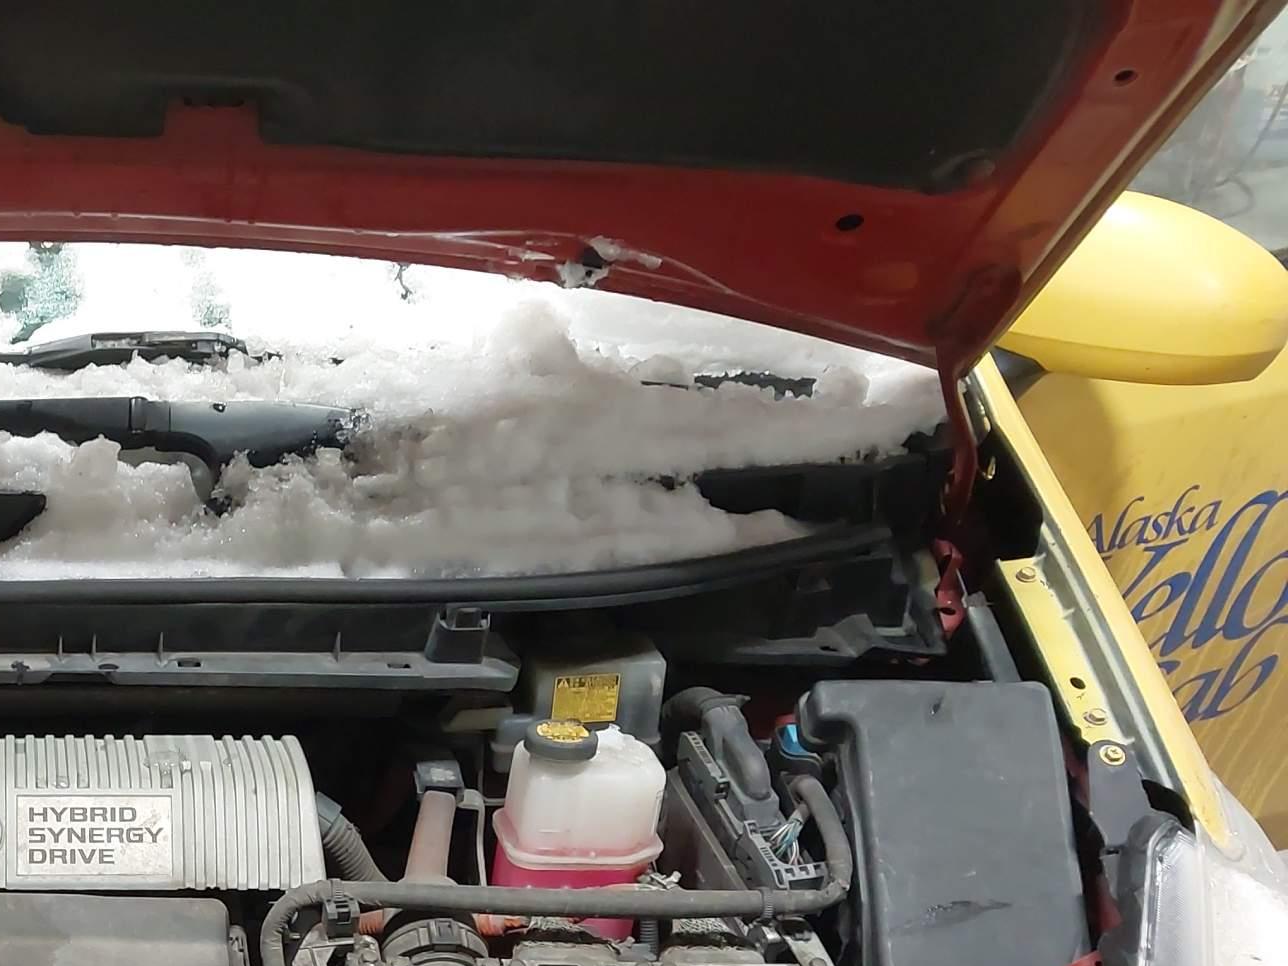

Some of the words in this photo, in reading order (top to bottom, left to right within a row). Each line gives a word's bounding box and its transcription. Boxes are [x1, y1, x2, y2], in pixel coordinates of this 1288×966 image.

[1086, 484, 1223, 557] Alaska
[28, 806, 137, 823] HYBRID
[27, 827, 164, 844] SYNERGY
[28, 848, 116, 865] DRIVE
